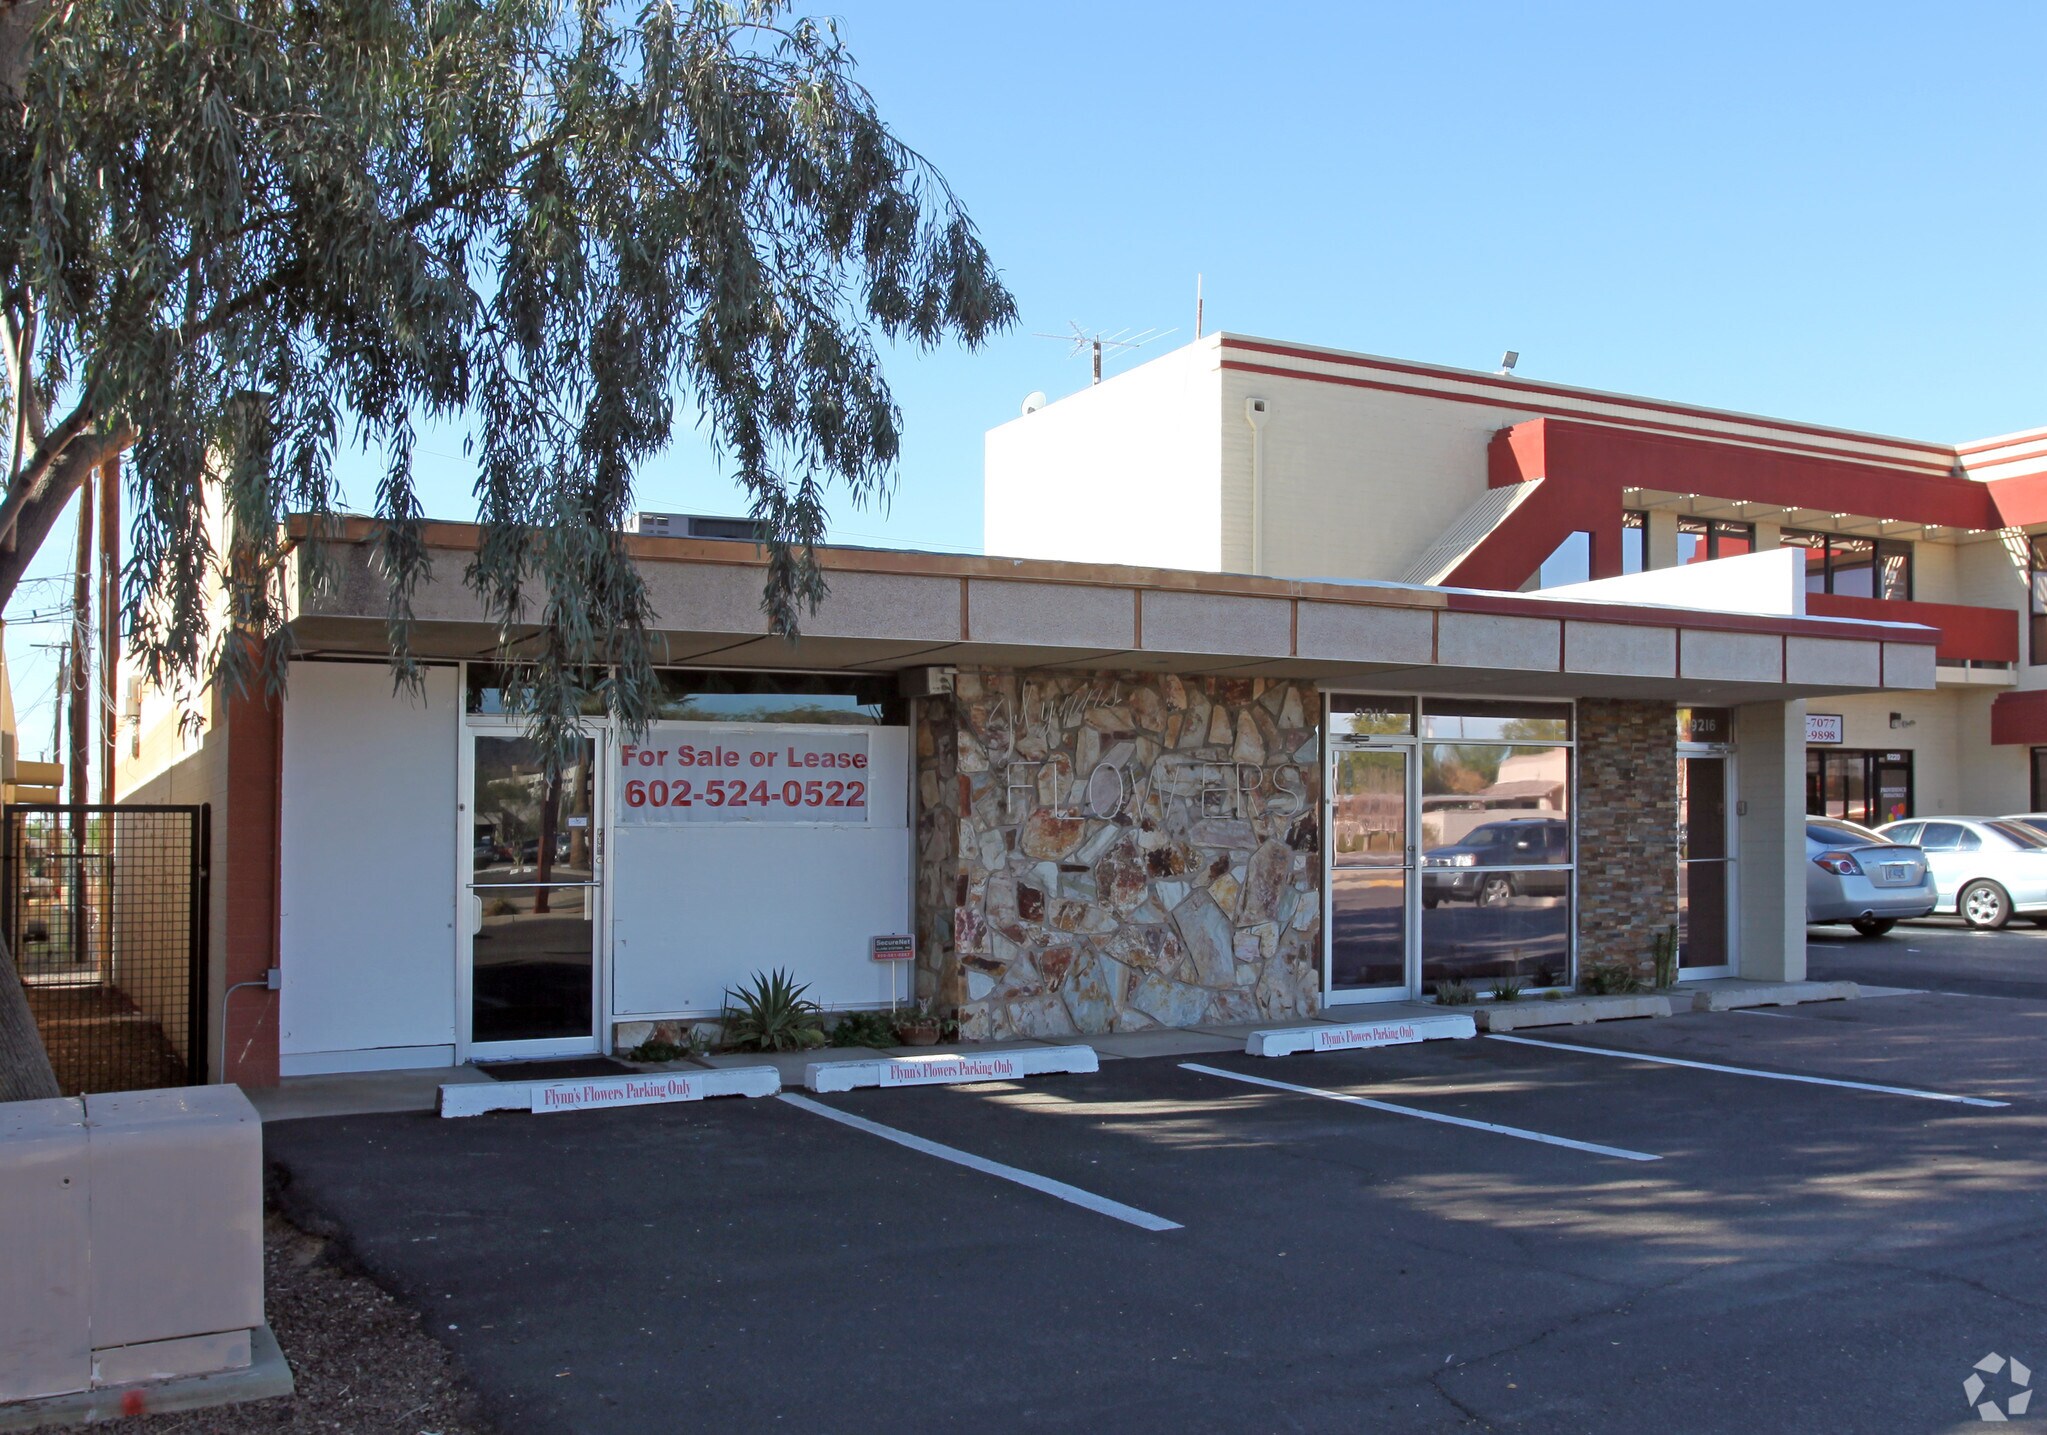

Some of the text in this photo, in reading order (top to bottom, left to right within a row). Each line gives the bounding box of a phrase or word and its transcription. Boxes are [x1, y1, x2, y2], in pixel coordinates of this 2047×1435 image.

[1354, 707, 1388, 722] 9214
[1691, 718, 1717, 731] 9216
[1806, 730, 1835, 740] -9898
[621, 744, 868, 769] For Sale or Lease
[624, 779, 865, 808] 602-524-0522
[1007, 762, 1299, 820] FLOWERS
[876, 938, 911, 946] SecureNet
[1321, 1024, 1414, 1048] Flynn's Flowers Parking Only
[890, 1058, 1013, 1083] Flynn's Flowers Parking Only
[544, 1079, 691, 1109] Flynn's Flowers Parking Only
